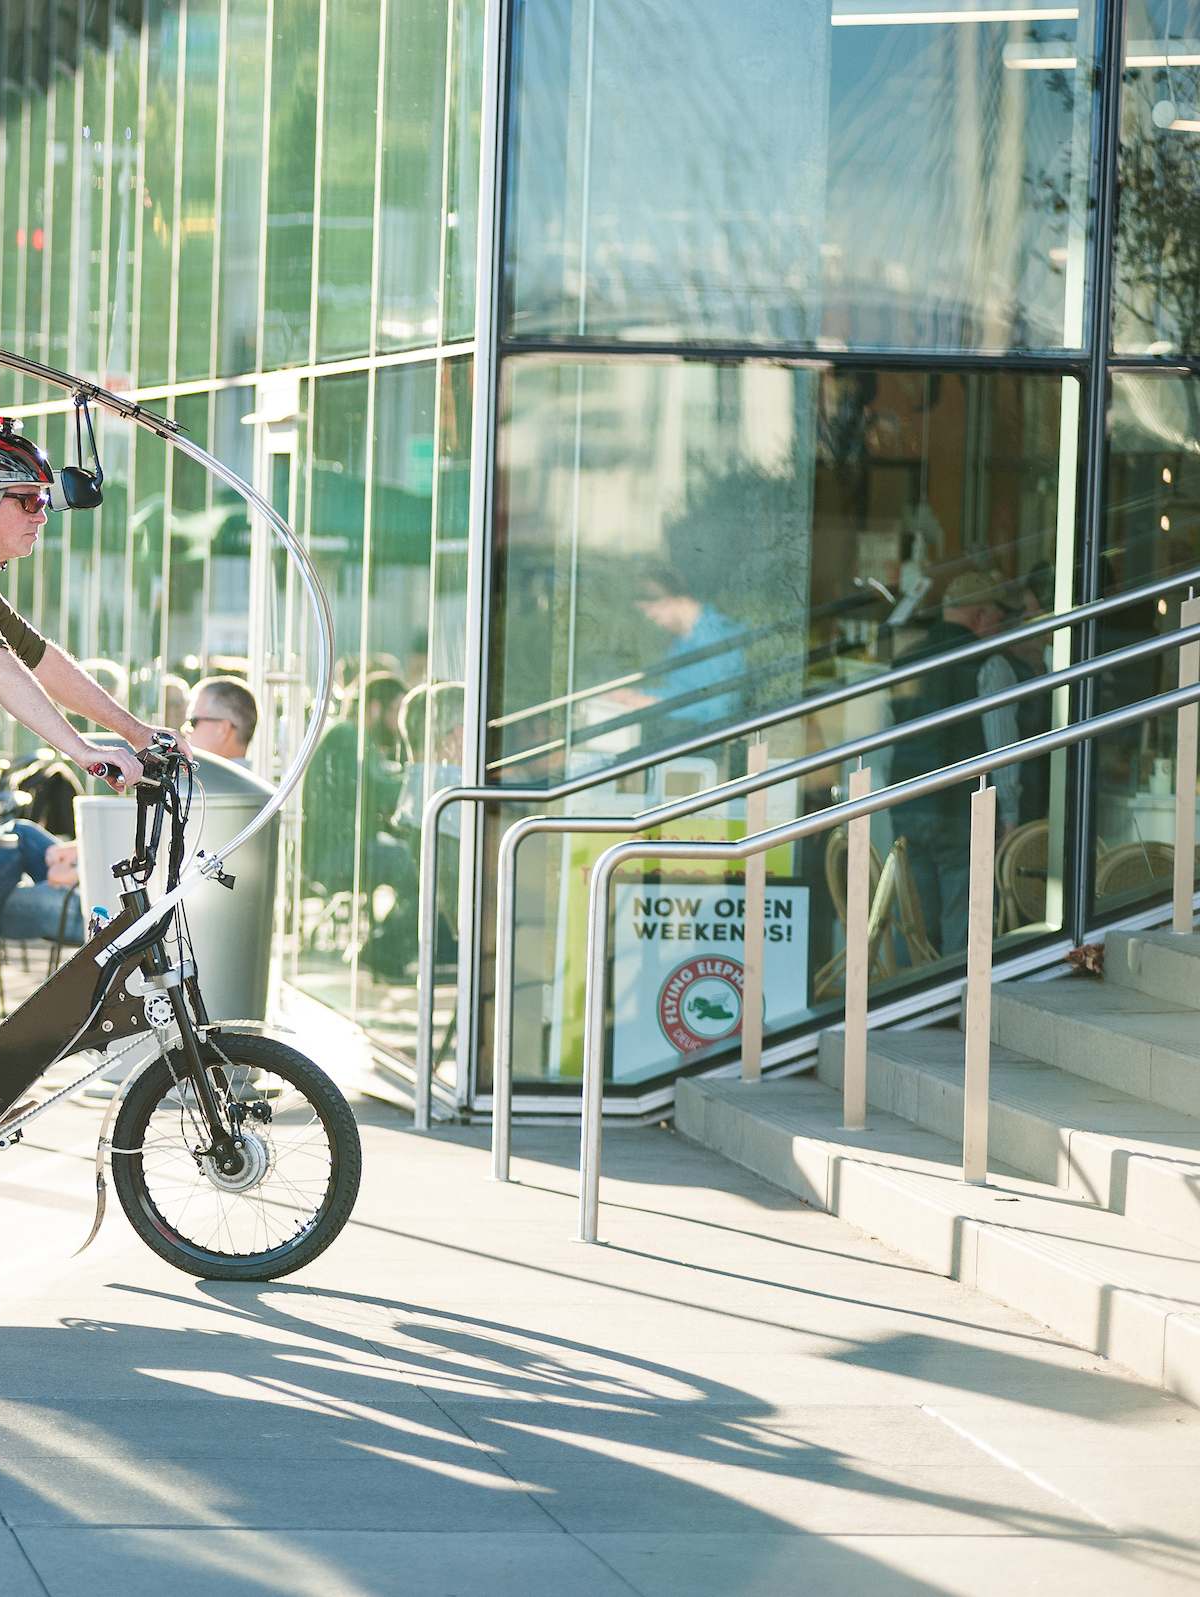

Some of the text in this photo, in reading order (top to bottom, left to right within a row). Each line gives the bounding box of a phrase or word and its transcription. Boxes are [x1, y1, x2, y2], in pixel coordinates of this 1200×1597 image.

[632, 897, 702, 917] NOW
[632, 921, 793, 943] WEEKENS!
[663, 960, 745, 1025] FLYING ELEPH
